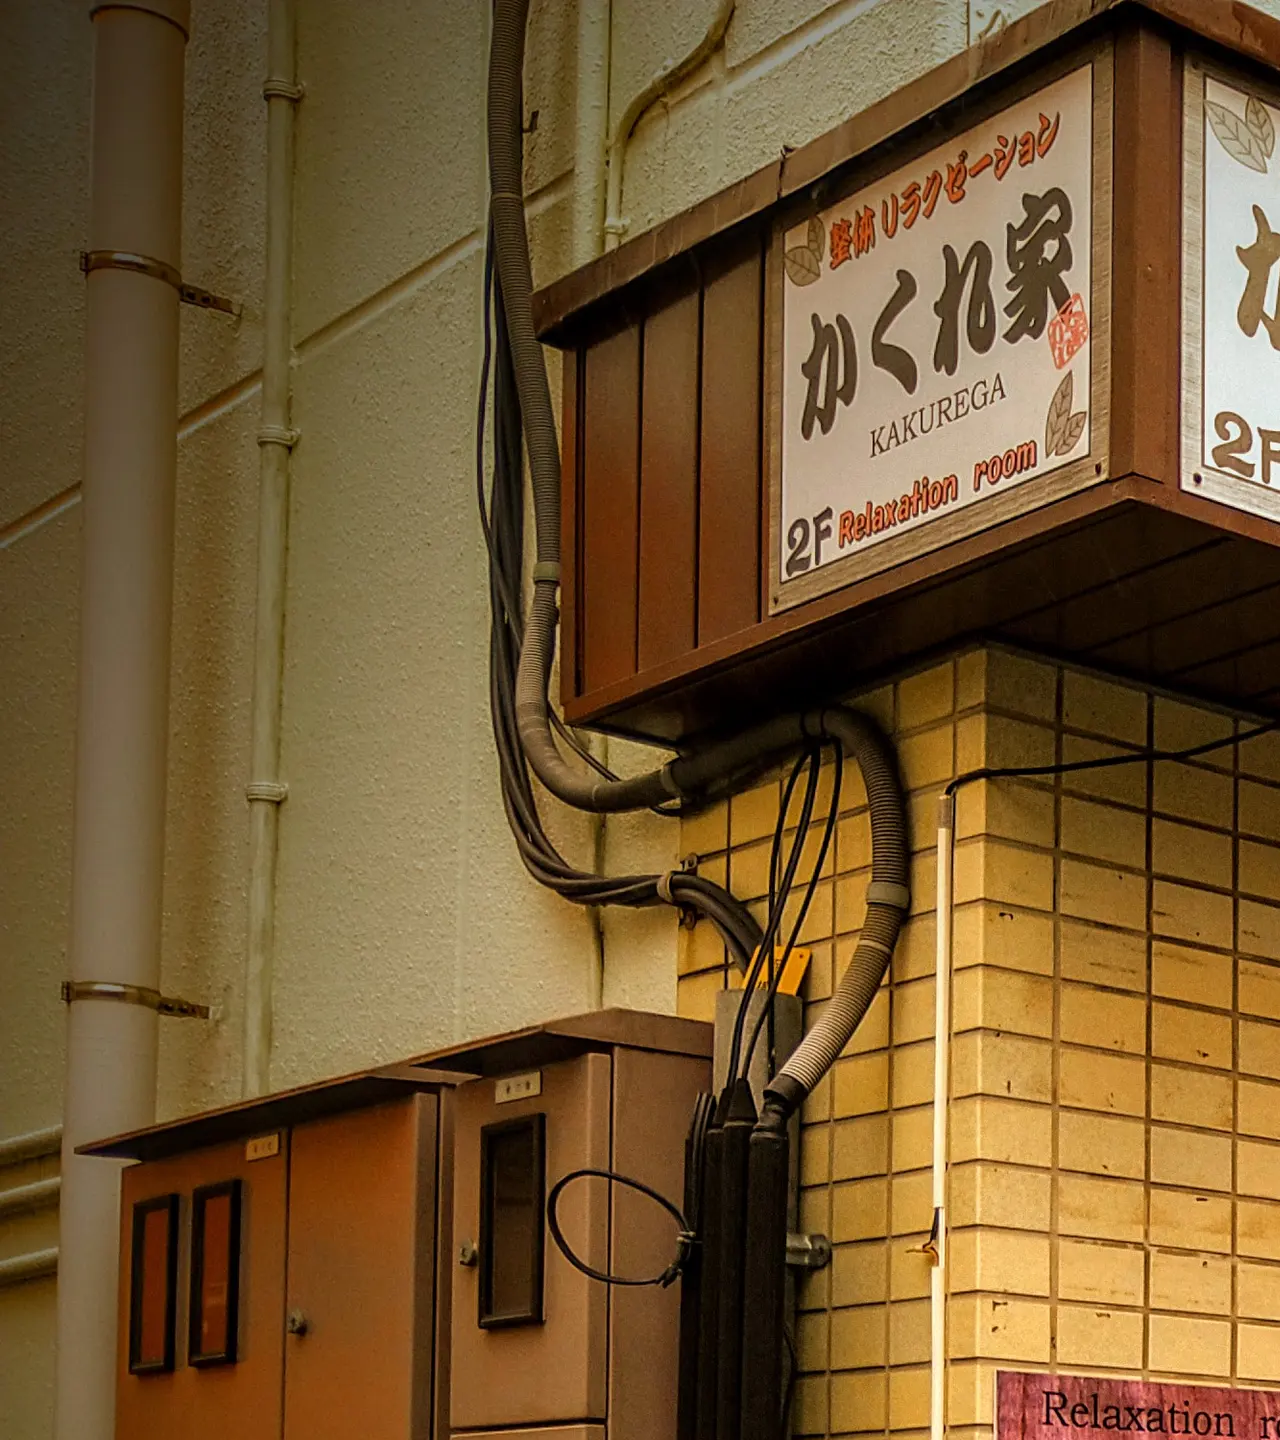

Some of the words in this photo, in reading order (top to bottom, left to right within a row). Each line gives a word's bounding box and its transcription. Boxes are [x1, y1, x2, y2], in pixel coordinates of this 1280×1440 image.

[829, 204, 876, 271] 整体
[881, 111, 1061, 238] リラクゼーション
[800, 187, 1073, 441] かくれ家
[870, 373, 1007, 458] KAKUREGA
[786, 507, 833, 577] 2F
[838, 473, 958, 548] Relaxation
[973, 439, 1037, 488] room
[1042, 1390, 1235, 1438] Relaxation
